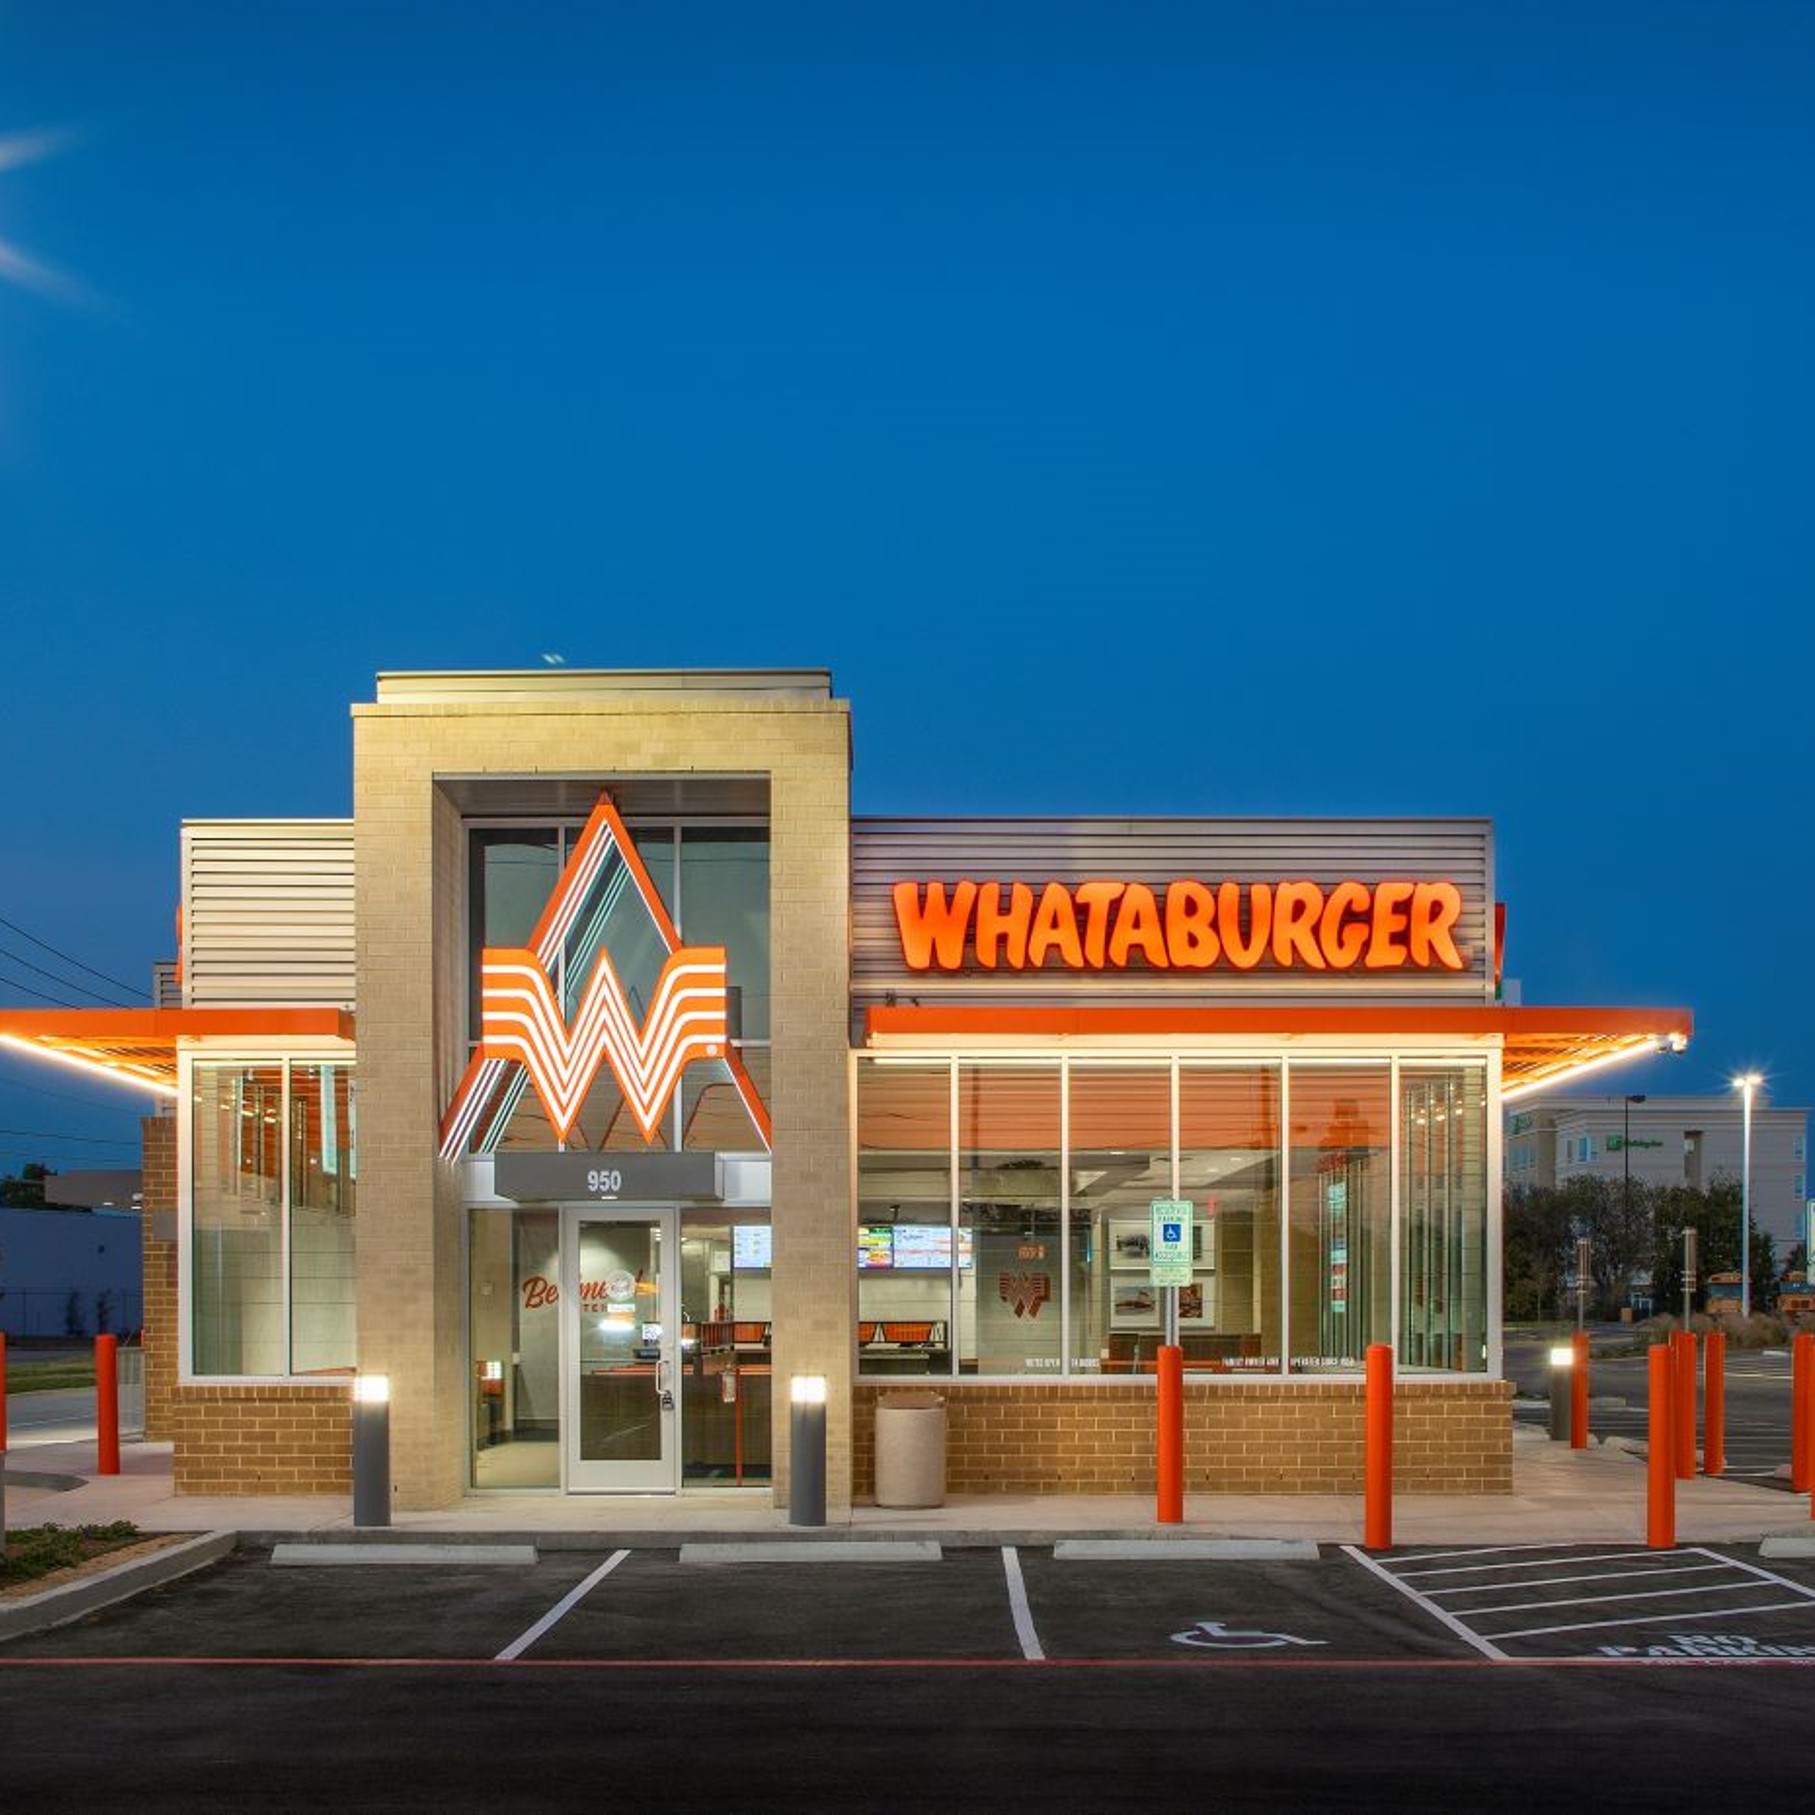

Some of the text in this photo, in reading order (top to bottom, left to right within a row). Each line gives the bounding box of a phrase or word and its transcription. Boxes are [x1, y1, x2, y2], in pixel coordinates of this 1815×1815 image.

[892, 880, 1464, 971] WHATABURGER
[587, 1170, 622, 1192] 950
[1599, 1645, 1815, 1657] PARKIN
